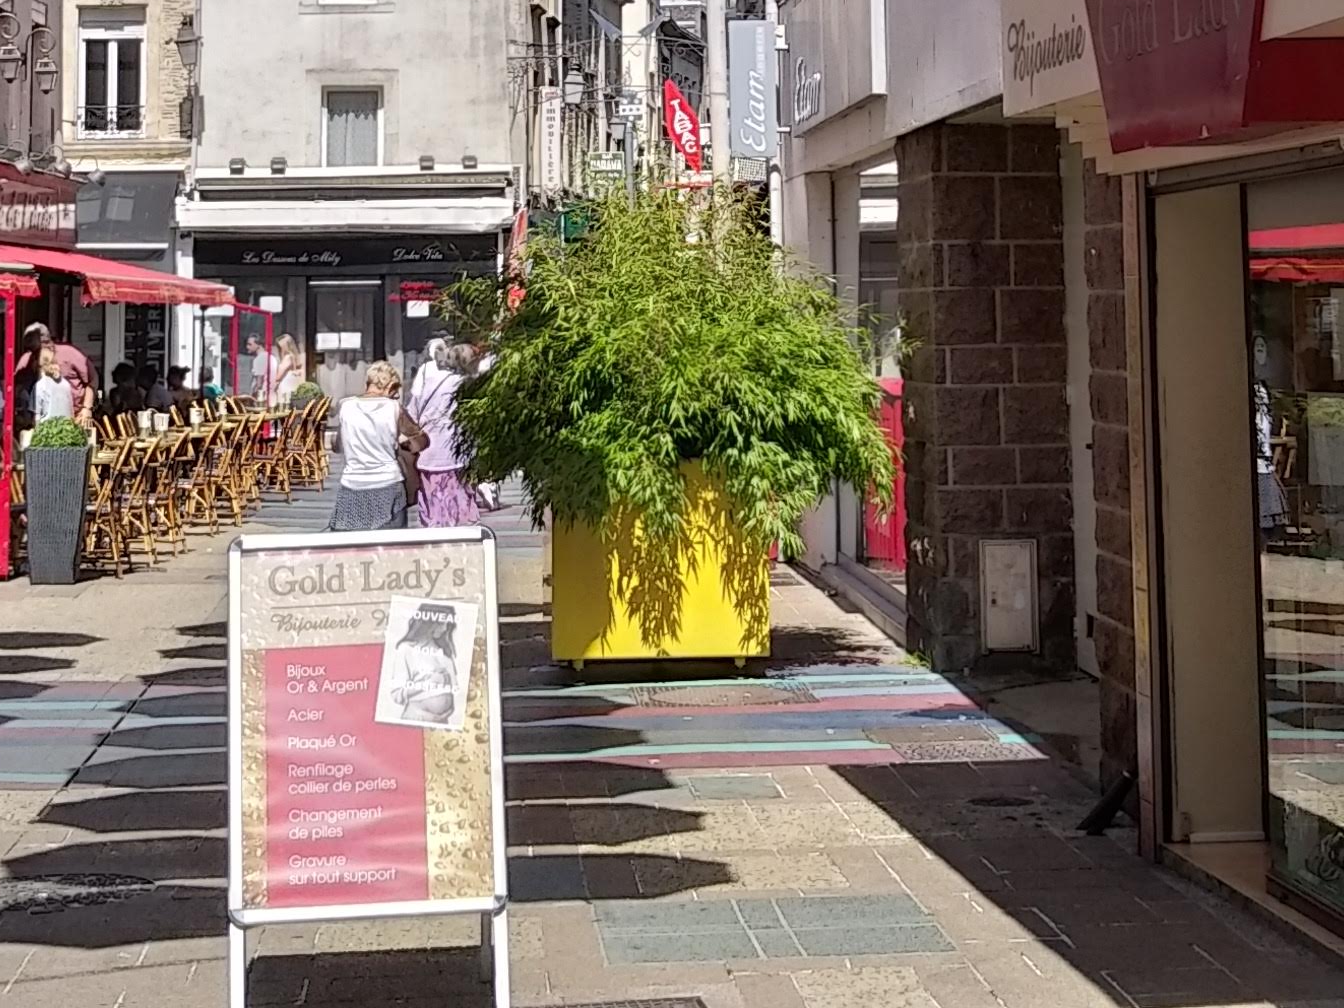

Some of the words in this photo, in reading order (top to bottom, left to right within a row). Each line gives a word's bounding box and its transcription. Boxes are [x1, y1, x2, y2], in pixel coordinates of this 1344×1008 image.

[1008, 13, 1087, 96] Bijouterie
[794, 56, 821, 126] Etam
[740, 69, 767, 152] Etam
[670, 99, 697, 153] TABAC
[268, 563, 346, 596] Gold
[360, 557, 466, 598] Lady's
[270, 612, 361, 635] Bijouterie
[286, 664, 327, 679] Bijoux
[286, 679, 306, 693] Or
[308, 679, 319, 693] &
[321, 677, 369, 696] Argent
[286, 708, 325, 722] Acier
[286, 735, 337, 751] Plaqué
[338, 734, 358, 748] Or
[287, 763, 354, 778] Renfilage
[288, 779, 330, 795] collier
[332, 779, 353, 793] de
[355, 777, 397, 792] perles
[288, 805, 383, 824] Changement
[288, 825, 308, 840] de
[311, 825, 344, 840] piles
[288, 854, 347, 868] Gravure
[288, 873, 310, 886] sur
[311, 869, 341, 885] tout
[342, 867, 397, 885] support
